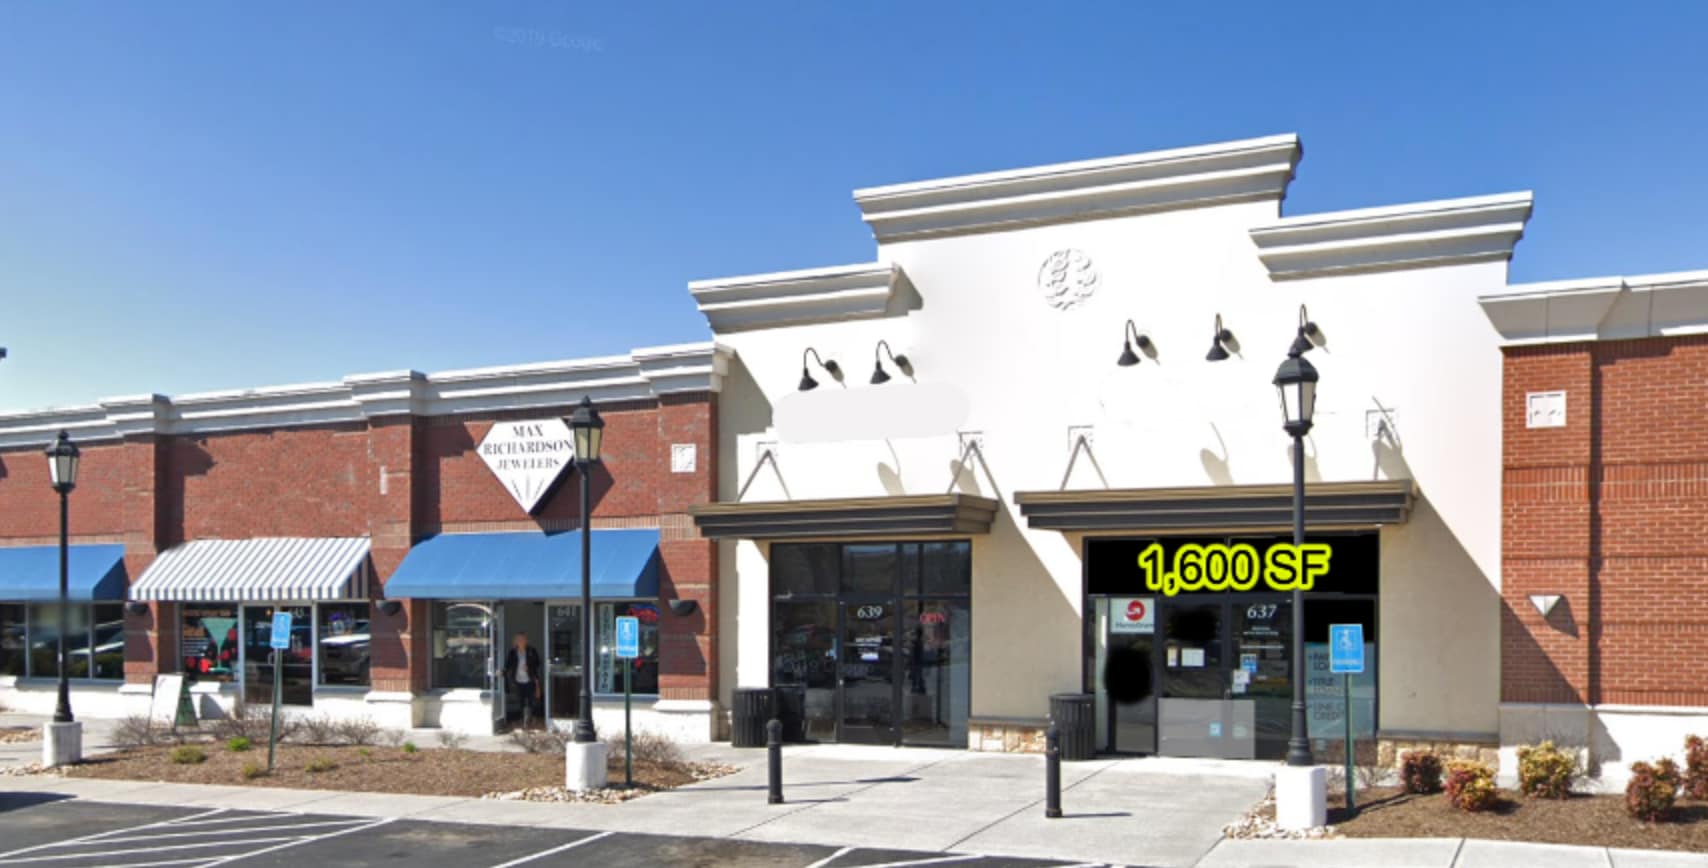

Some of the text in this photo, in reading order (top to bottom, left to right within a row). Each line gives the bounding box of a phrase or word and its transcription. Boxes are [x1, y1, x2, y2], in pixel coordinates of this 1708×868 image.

[512, 424, 544, 437] MAX
[483, 440, 573, 455] RICHARDSON
[497, 457, 560, 469] JEWELERS
[857, 605, 883, 619] 639
[1247, 604, 1277, 618] 637
